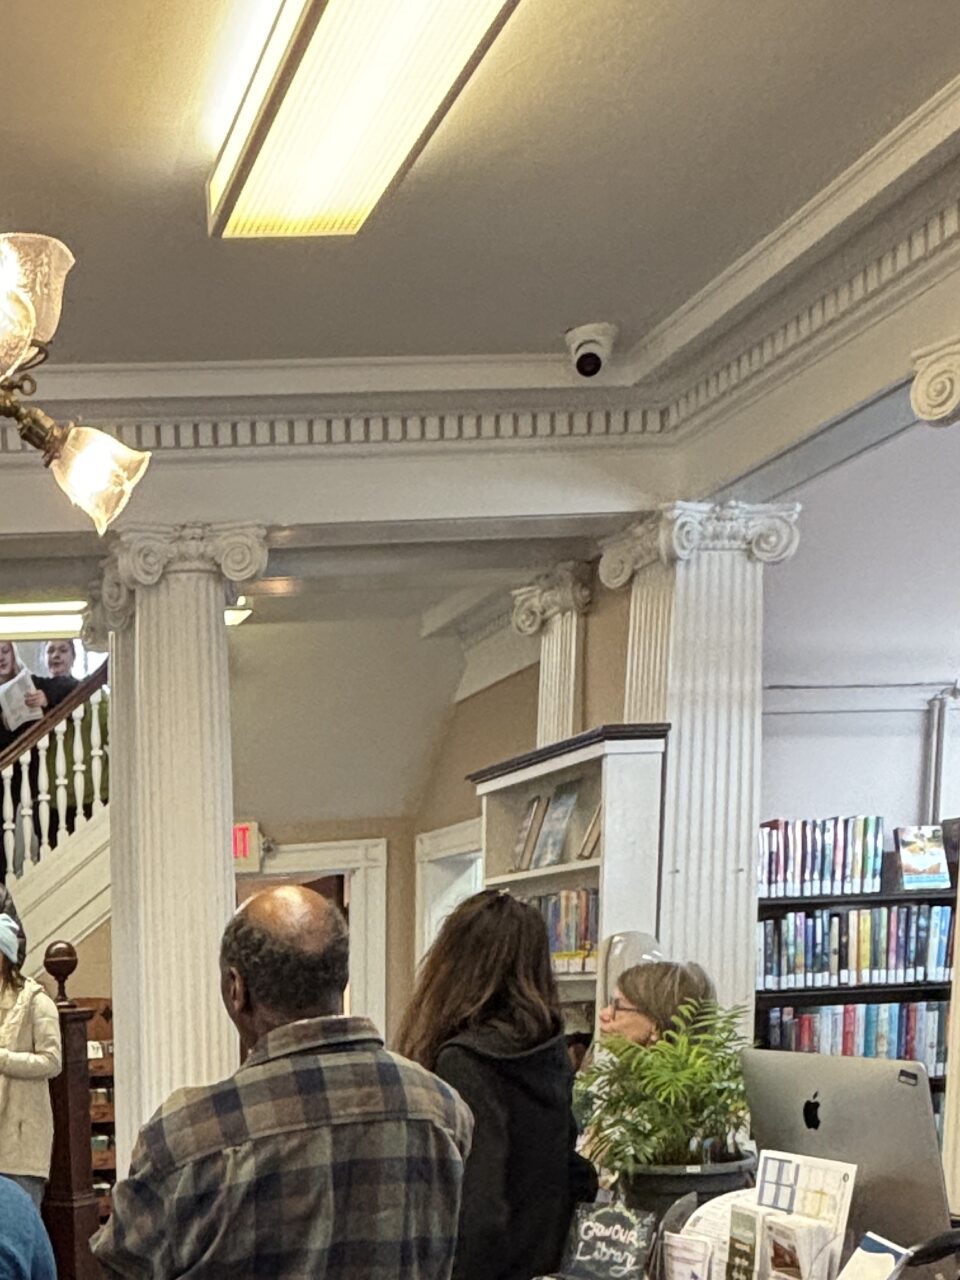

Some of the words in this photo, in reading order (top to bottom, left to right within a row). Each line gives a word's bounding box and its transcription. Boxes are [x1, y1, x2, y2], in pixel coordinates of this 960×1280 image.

[233, 825, 249, 859] IT
[611, 1224, 639, 1247] OUR
[575, 1240, 640, 1277] Library
